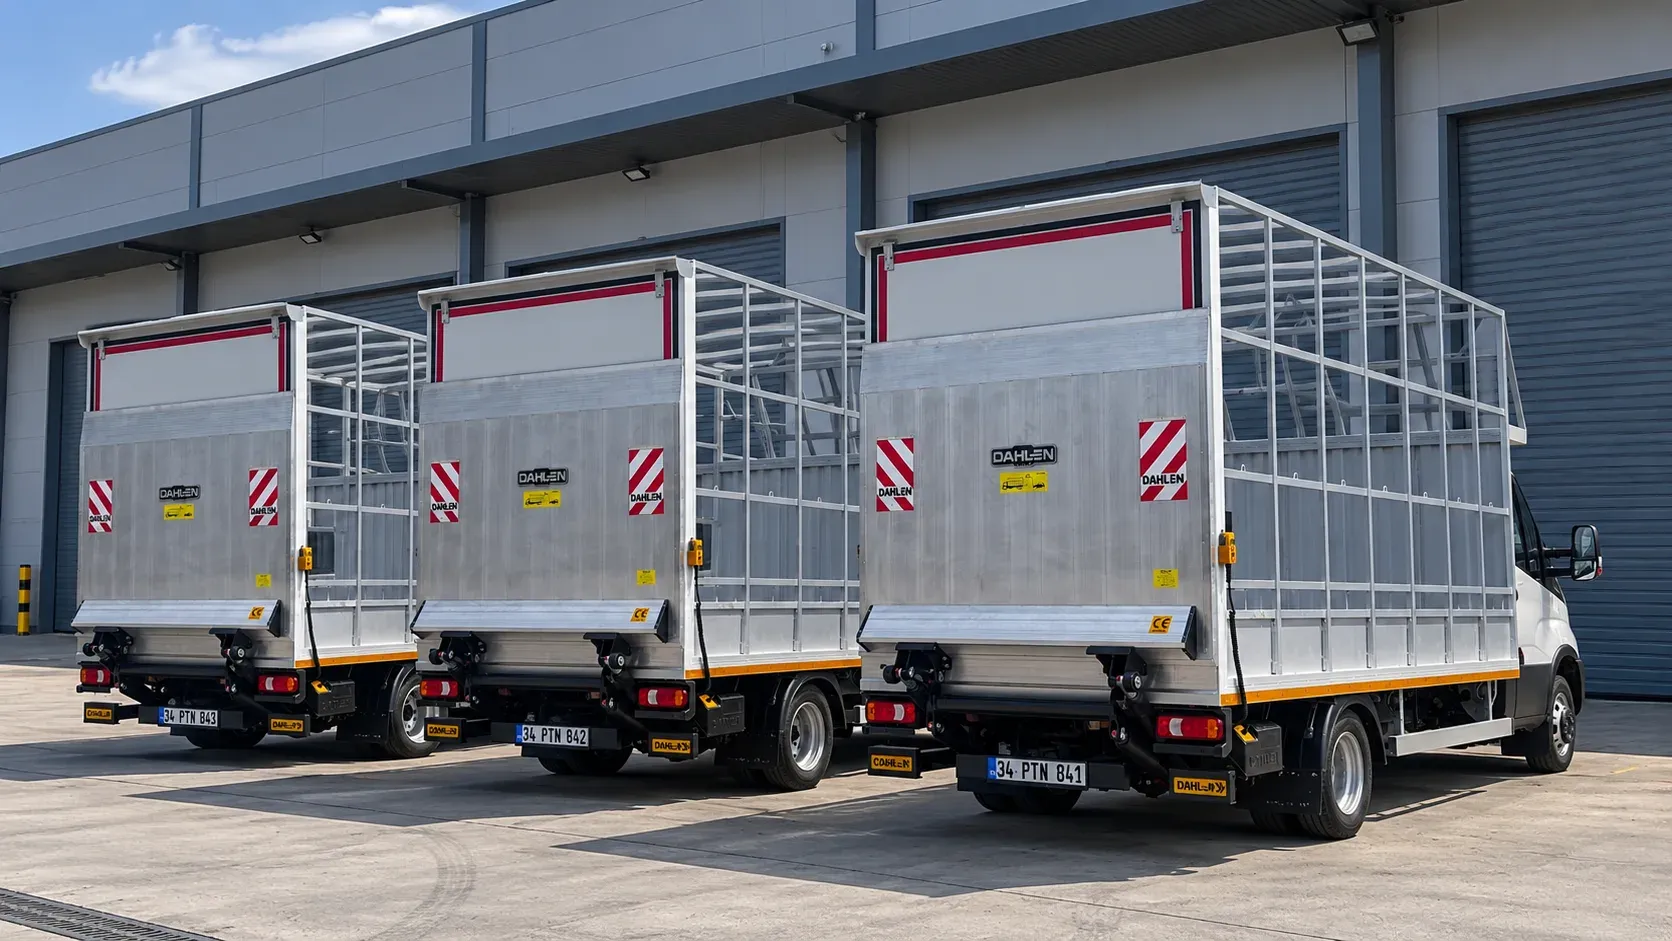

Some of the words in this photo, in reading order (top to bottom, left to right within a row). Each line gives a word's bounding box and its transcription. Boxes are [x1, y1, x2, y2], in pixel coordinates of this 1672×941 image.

[993, 448, 1054, 463] DAHLEN
[519, 471, 566, 483] DAHLEN
[1142, 473, 1184, 485] DAHLEN
[631, 493, 662, 502] DAHLEN
[878, 487, 912, 497] DAHLEN
[1153, 618, 1171, 629] CE
[164, 709, 175, 722] 34
[180, 710, 196, 724] PTN
[200, 711, 216, 725] 843
[523, 727, 536, 741] 34
[542, 728, 561, 743] PTN
[566, 729, 586, 745] 842
[997, 760, 1013, 778] 34
[1022, 762, 1048, 781] PTN
[1057, 764, 1082, 784] 841
